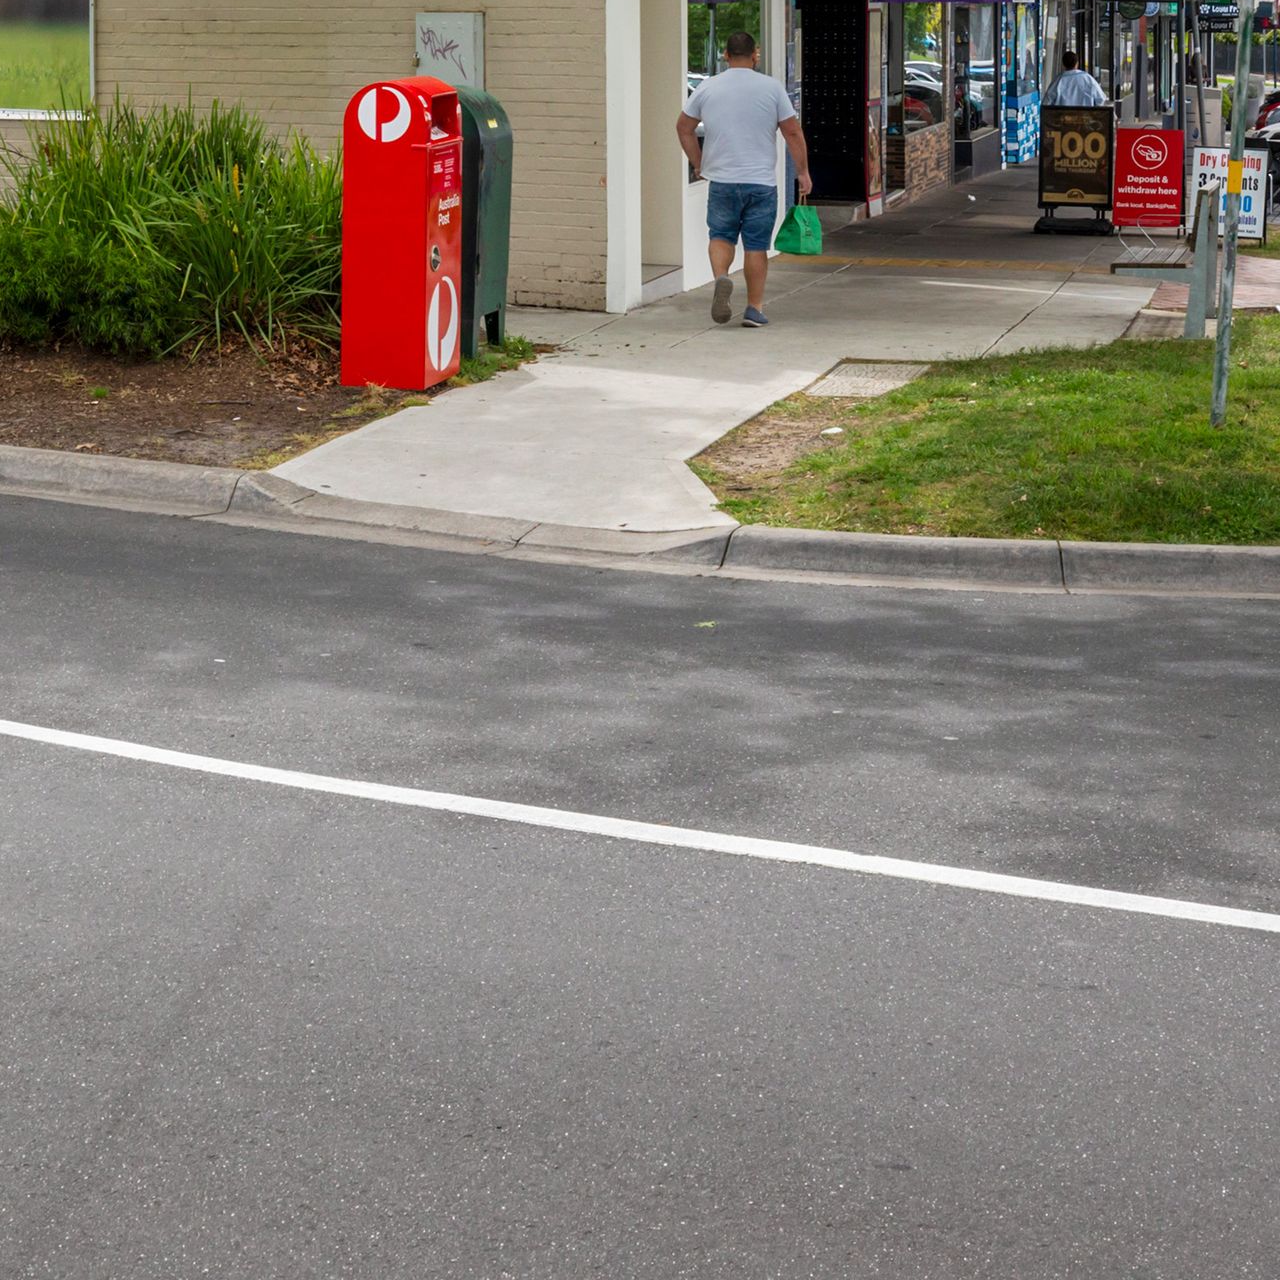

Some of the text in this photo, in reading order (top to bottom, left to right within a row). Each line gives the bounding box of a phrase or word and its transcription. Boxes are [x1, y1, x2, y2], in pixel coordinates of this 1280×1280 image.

[1054, 159, 1098, 169] MILLION
[1200, 153, 1217, 168] Dry
[1127, 175, 1169, 184] Deposit &
[1199, 173, 1207, 188] 3
[1117, 186, 1178, 195] withdraw here
